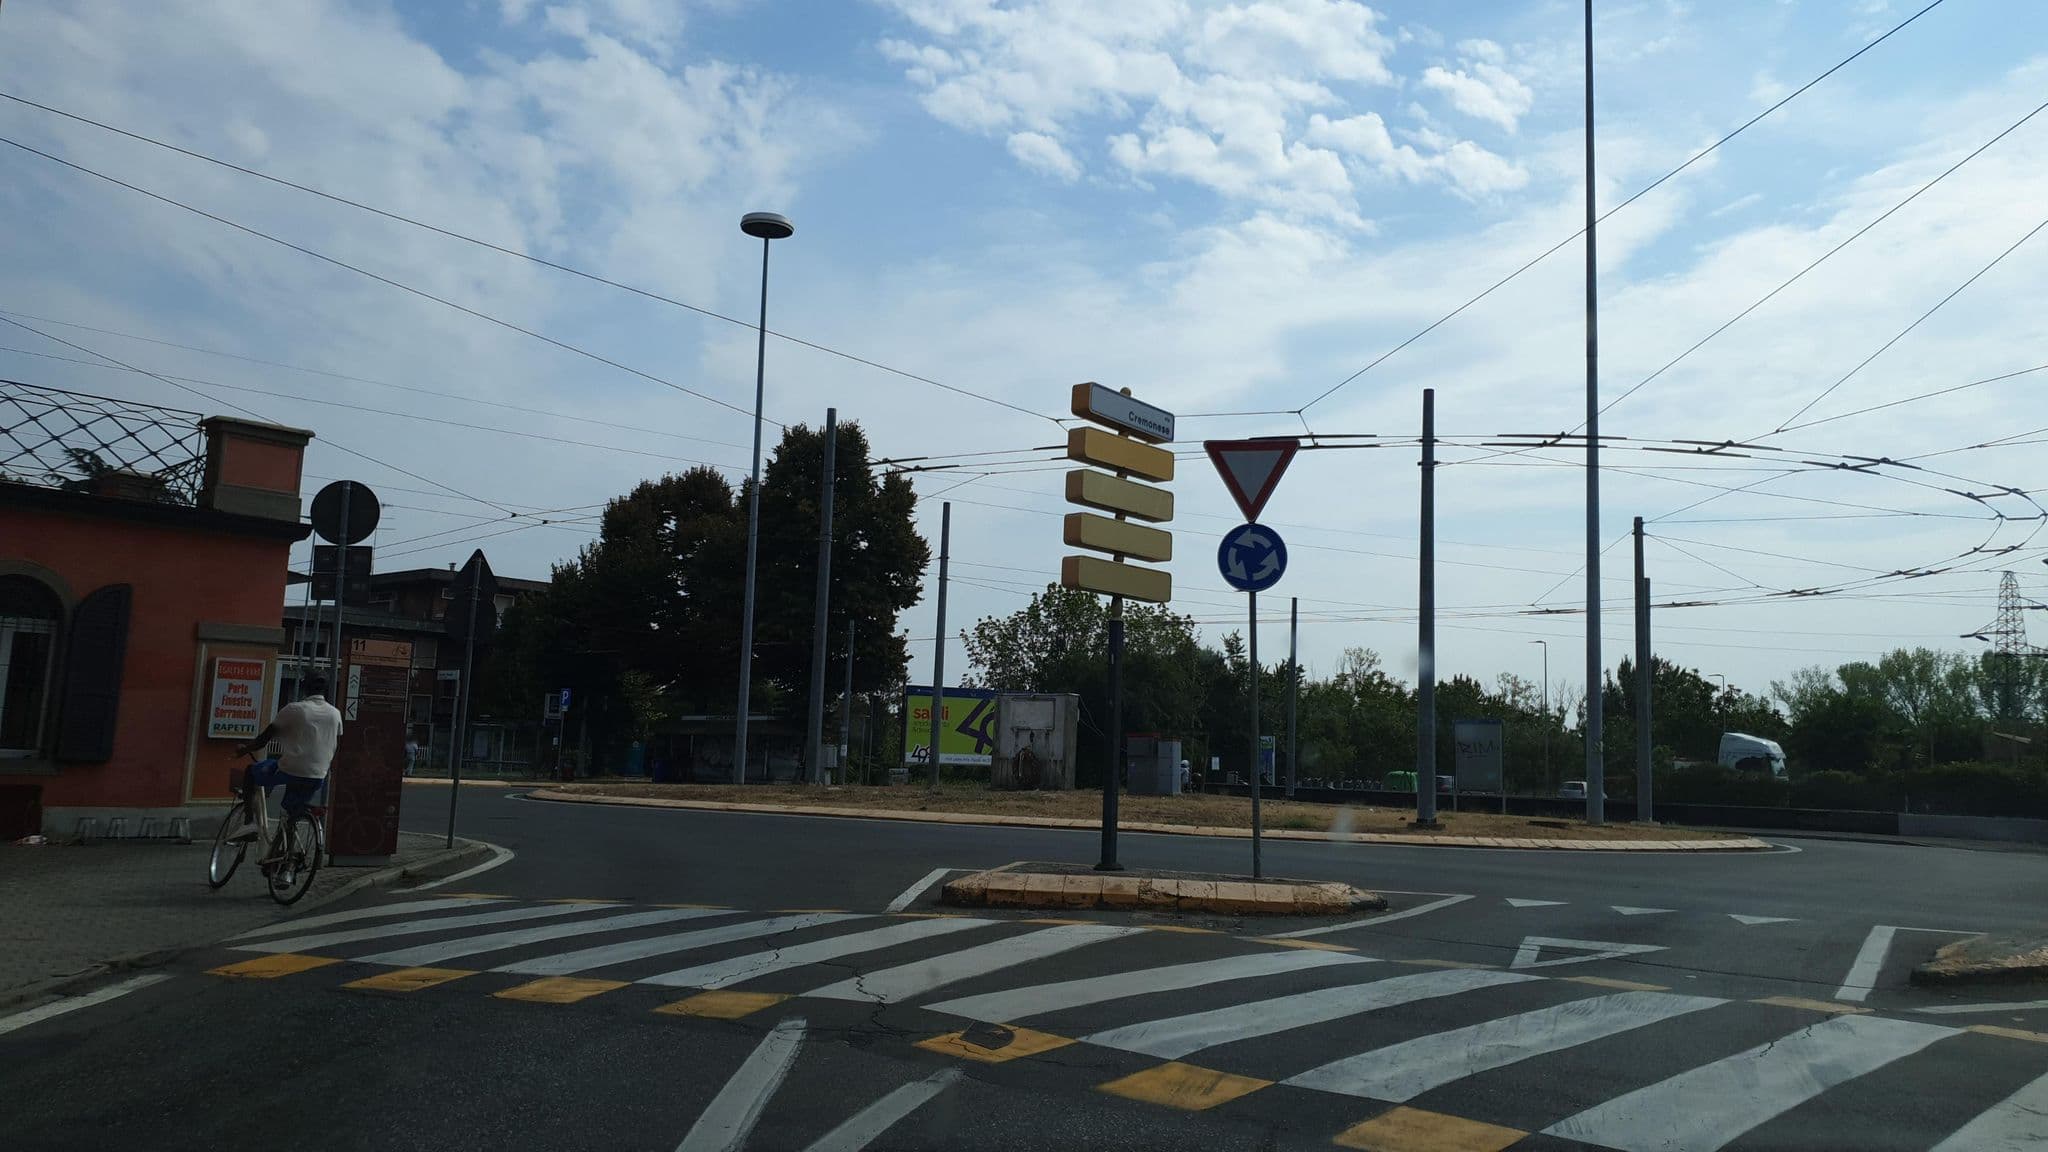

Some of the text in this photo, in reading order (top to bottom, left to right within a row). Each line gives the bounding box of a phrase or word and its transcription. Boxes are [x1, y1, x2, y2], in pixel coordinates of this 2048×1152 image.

[1128, 411, 1170, 435] Cremonese
[353, 640, 366, 651] 11
[228, 683, 249, 694] Porte
[221, 695, 252, 707] Finestre
[562, 690, 569, 704] P
[215, 707, 257, 720] Serramenti
[213, 723, 255, 732] RAPETTI
